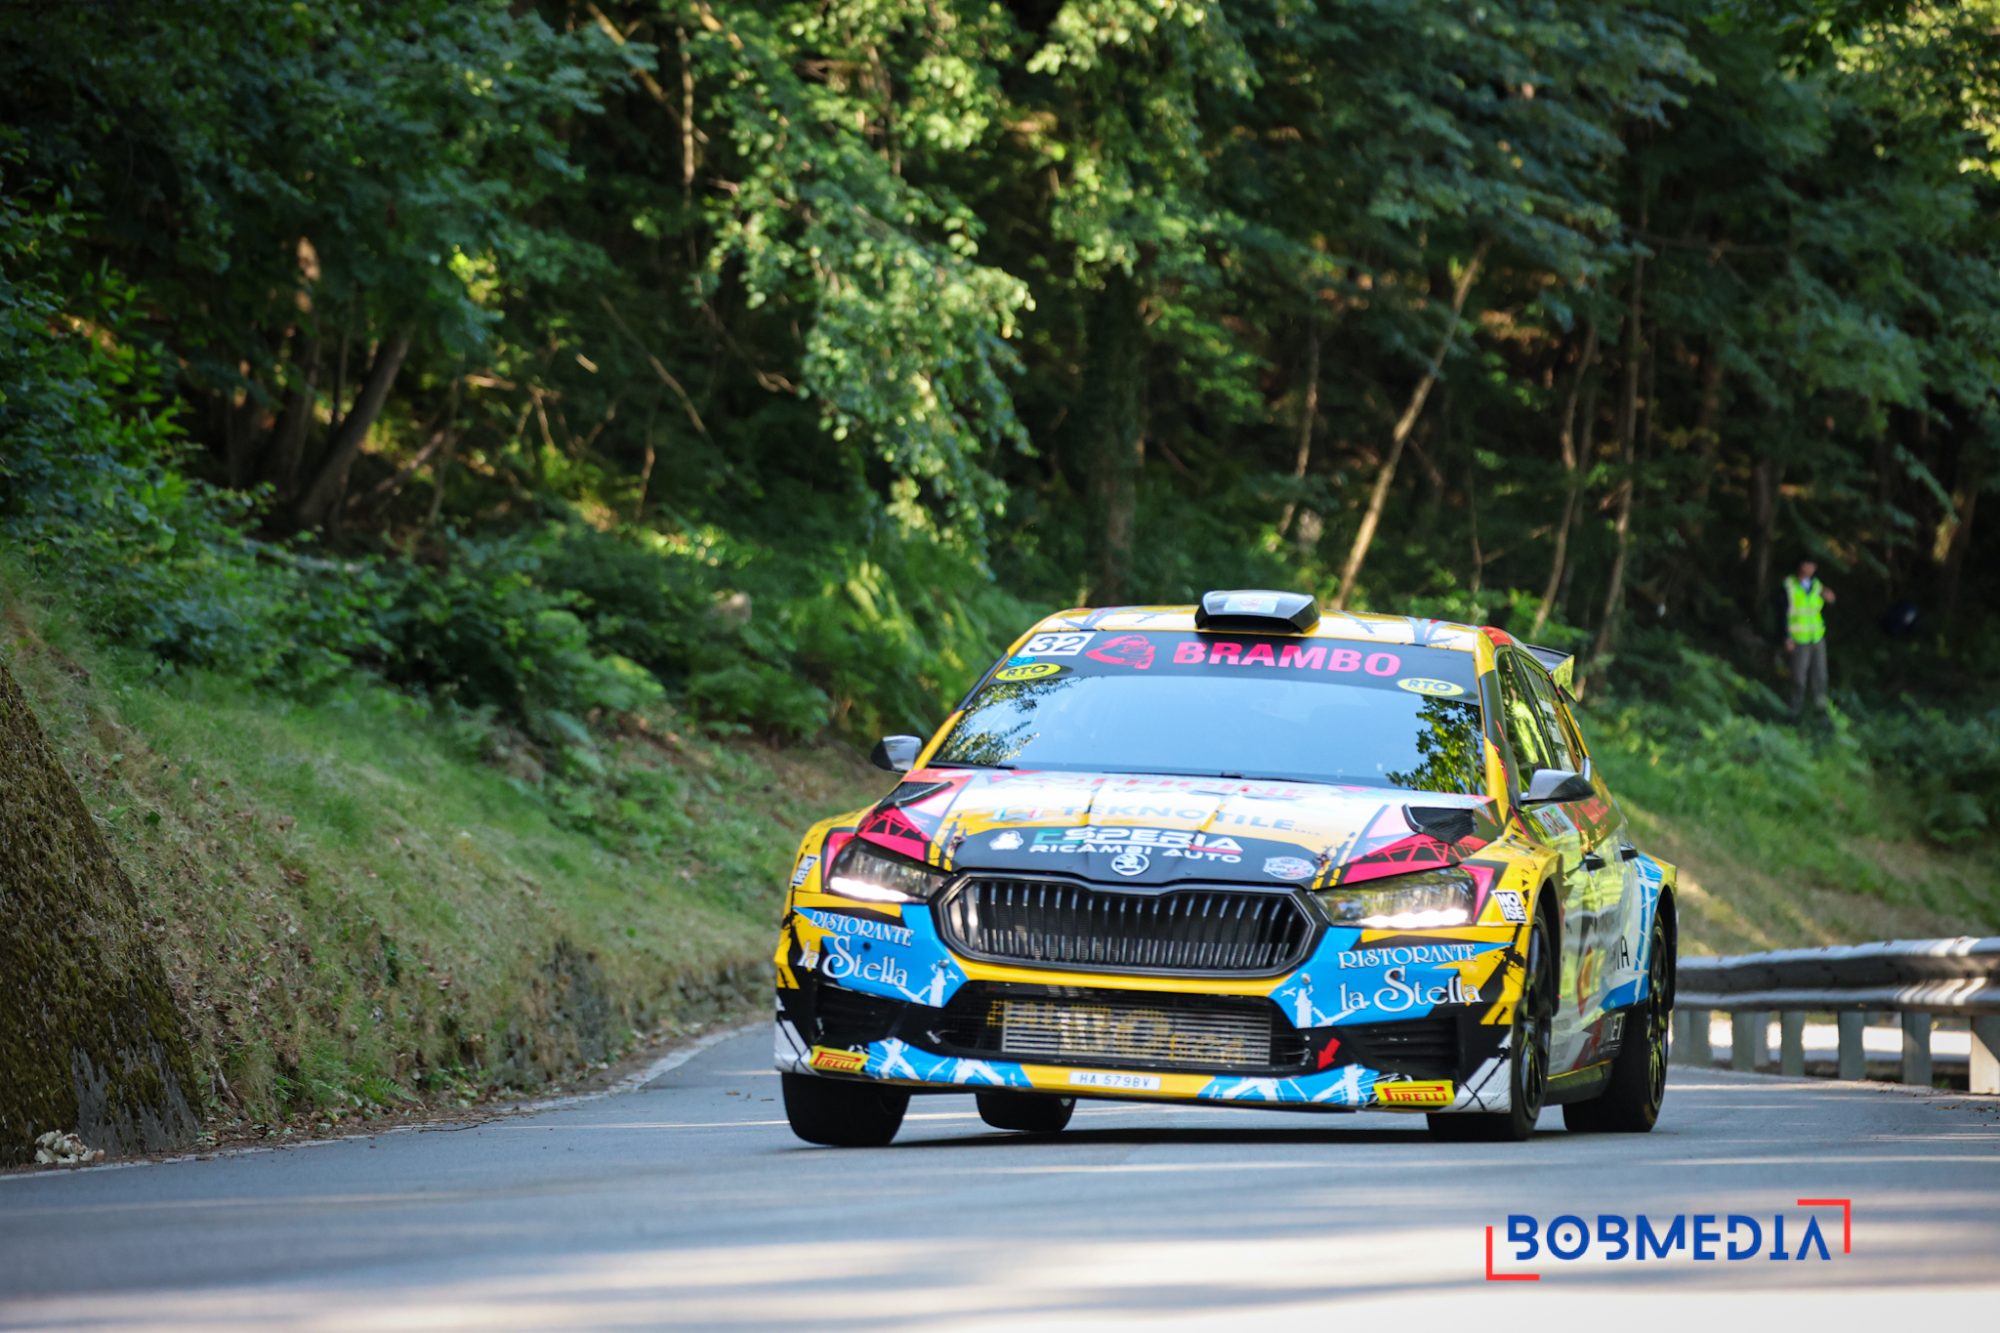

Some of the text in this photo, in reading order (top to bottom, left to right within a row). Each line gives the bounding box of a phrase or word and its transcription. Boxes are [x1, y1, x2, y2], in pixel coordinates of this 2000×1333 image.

[1028, 636, 1086, 653] 32
[1006, 664, 1050, 677] RTO
[1173, 642, 1401, 677] BRAMBO
[1407, 679, 1453, 692] RTO
[1062, 805, 1297, 831] TEKNOTILE
[1033, 827, 1243, 851] ESPERIA
[1029, 843, 1242, 863] RICAMBI AUTO
[809, 910, 914, 946] RISTORANTE
[797, 935, 909, 988] la Stella
[1338, 944, 1477, 969] RISTORANTE
[1340, 966, 1484, 1012] la Stella
[813, 1051, 862, 1071] PIRELLI
[1080, 1073, 1096, 1084] HA
[1383, 1086, 1447, 1102] PIRELLI
